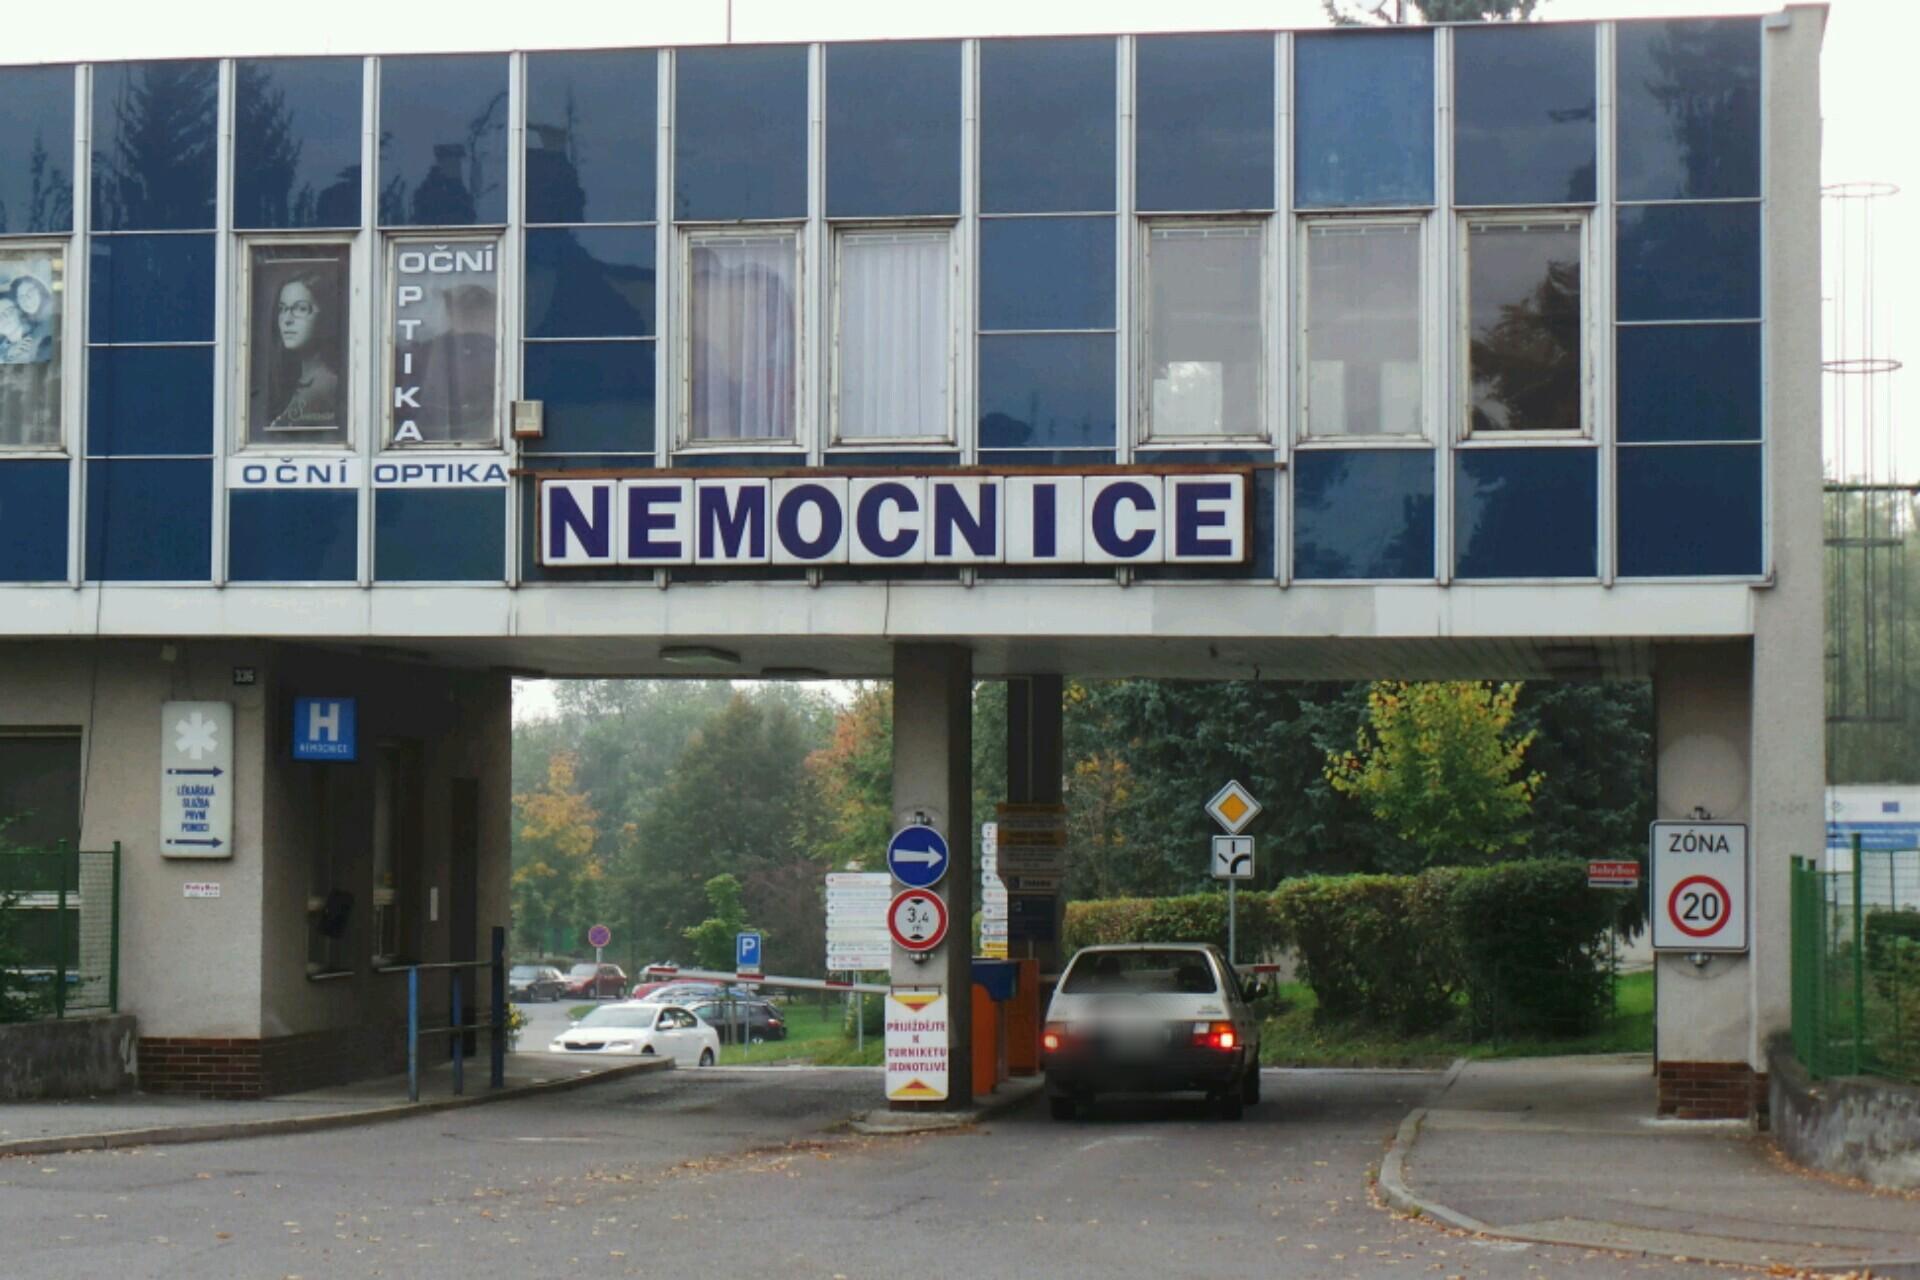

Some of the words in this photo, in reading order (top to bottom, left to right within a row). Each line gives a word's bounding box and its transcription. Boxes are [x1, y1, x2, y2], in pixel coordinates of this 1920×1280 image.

[398, 244, 494, 273] OČNÍ
[242, 457, 347, 484] OČNÍ
[374, 463, 507, 484] OPTIKA
[548, 481, 1233, 558] NEMOCNICE
[309, 702, 339, 742] H
[1669, 829, 1730, 853] ZÓNA
[1682, 892, 1719, 921] 20
[742, 938, 756, 956] P
[888, 1048, 947, 1057] TURNIKETU
